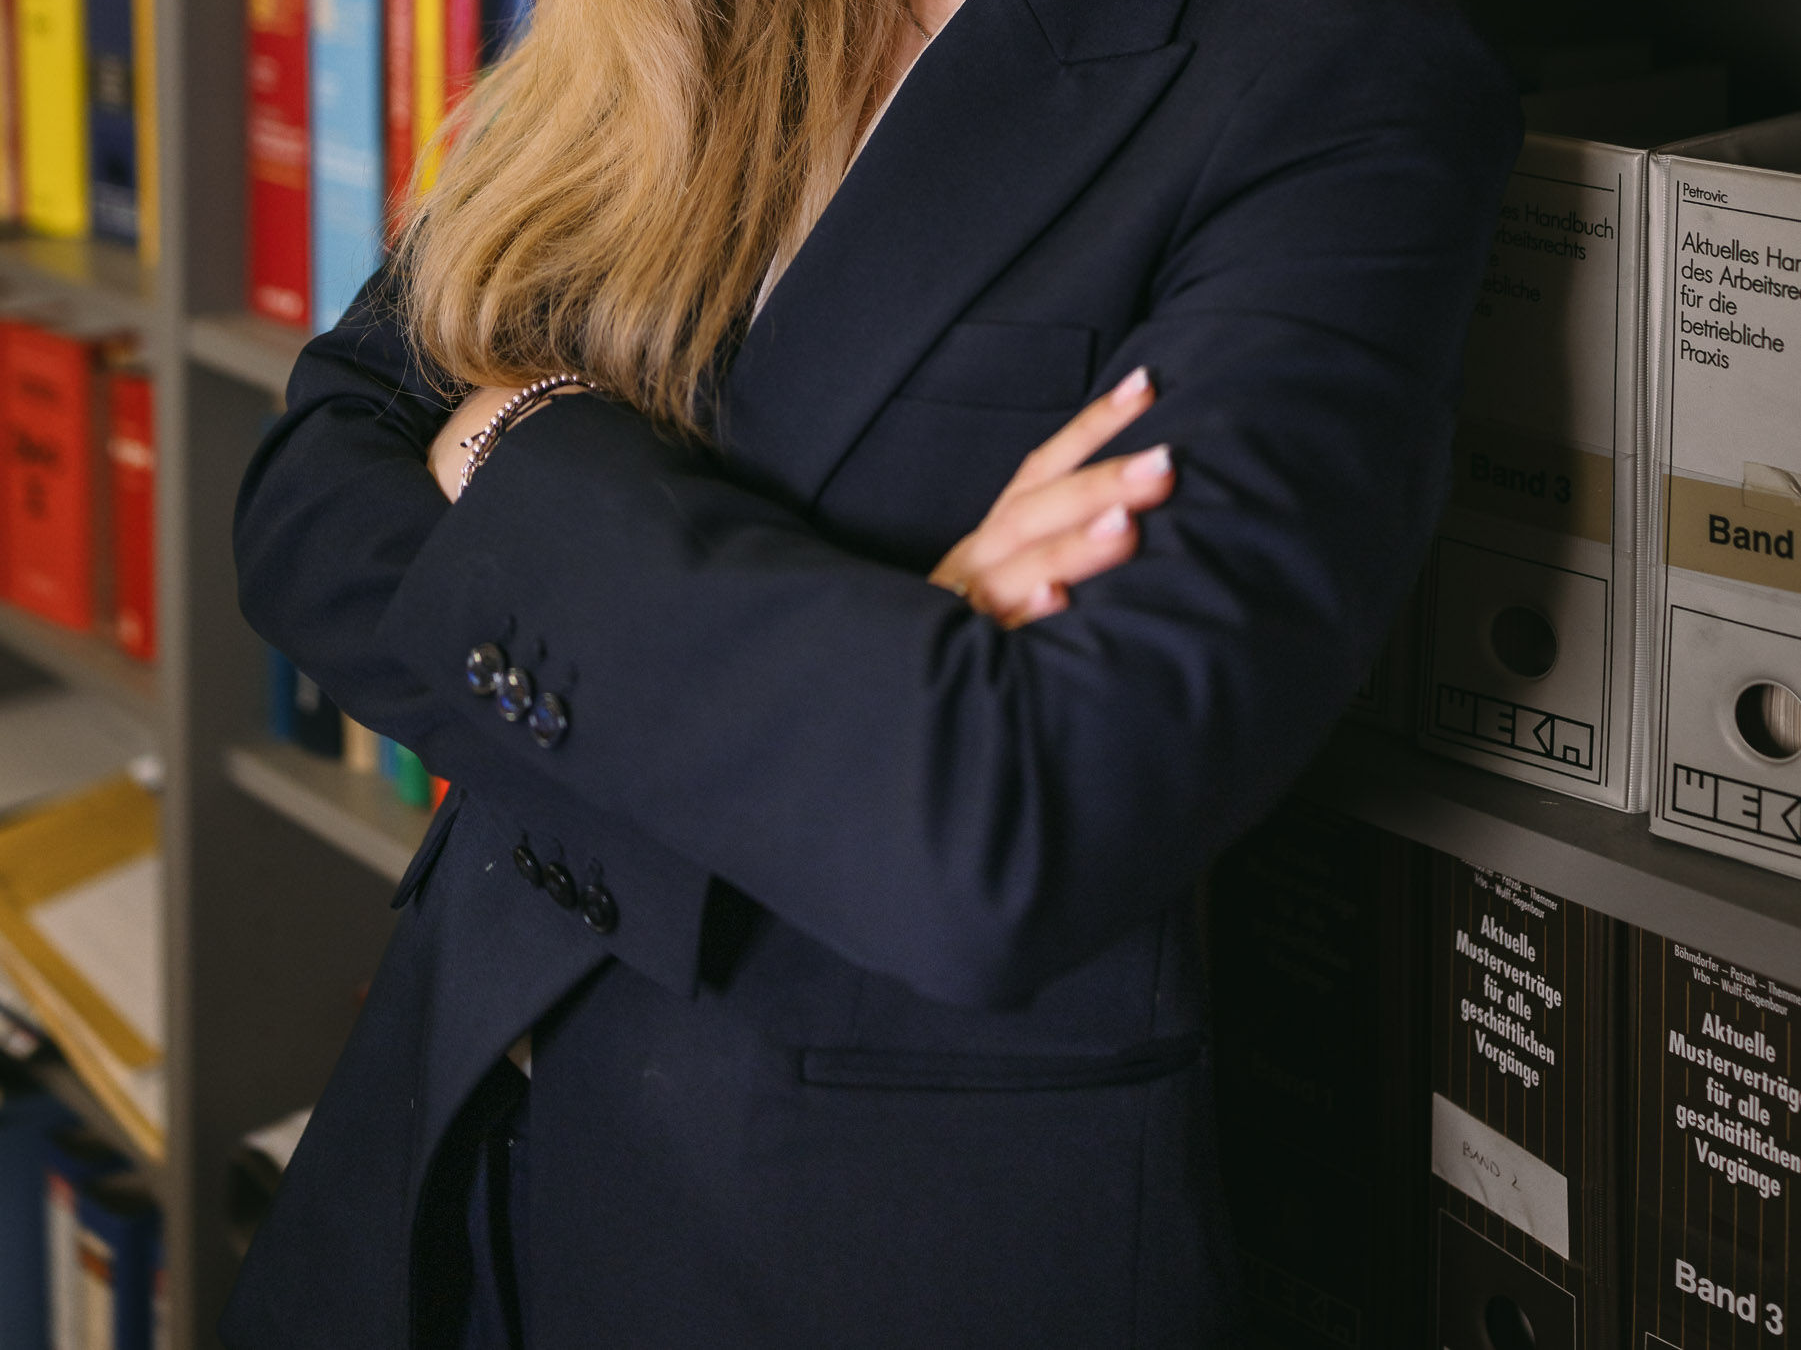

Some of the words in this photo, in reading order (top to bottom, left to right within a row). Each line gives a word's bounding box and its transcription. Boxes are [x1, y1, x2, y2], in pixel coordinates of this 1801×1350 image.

[1683, 182, 1728, 205] Petrovic
[1493, 223, 1587, 261] rbeitsrechts
[1525, 202, 1614, 240] Handbuch
[1681, 231, 1760, 266] Aktuelles
[1680, 284, 1704, 309] für
[1709, 291, 1738, 316] die
[1681, 258, 1713, 284] des
[1718, 265, 1801, 300] Arbeitsre
[1680, 311, 1785, 353] betriebliche
[1680, 339, 1730, 370] Praxis
[1469, 451, 1547, 499] Band
[1554, 475, 1572, 505] 3
[1708, 513, 1795, 561] Band
[1672, 762, 1801, 845] WEK
[1480, 914, 1536, 963] Aktuelle
[1456, 929, 1563, 1010] Musterverträge
[1674, 944, 1720, 973] Böhmdorfer
[1768, 980, 1801, 1007] Themme
[1692, 966, 1711, 985] Vrba
[1483, 973, 1504, 1005] für
[1506, 990, 1532, 1022] alle
[1460, 998, 1555, 1066] geschäftlichen
[1701, 1011, 1777, 1064] Aktuelle
[1474, 1029, 1540, 1089] Vorgänge
[1668, 1029, 1801, 1114] Musterverträg
[1705, 1076, 1733, 1110] für
[1737, 1094, 1771, 1127] alle
[1675, 1104, 1801, 1174] geschäftlichen
[1694, 1136, 1782, 1200] Vorgänge
[1675, 1258, 1756, 1325] Band
[1765, 1302, 1784, 1336] 3
